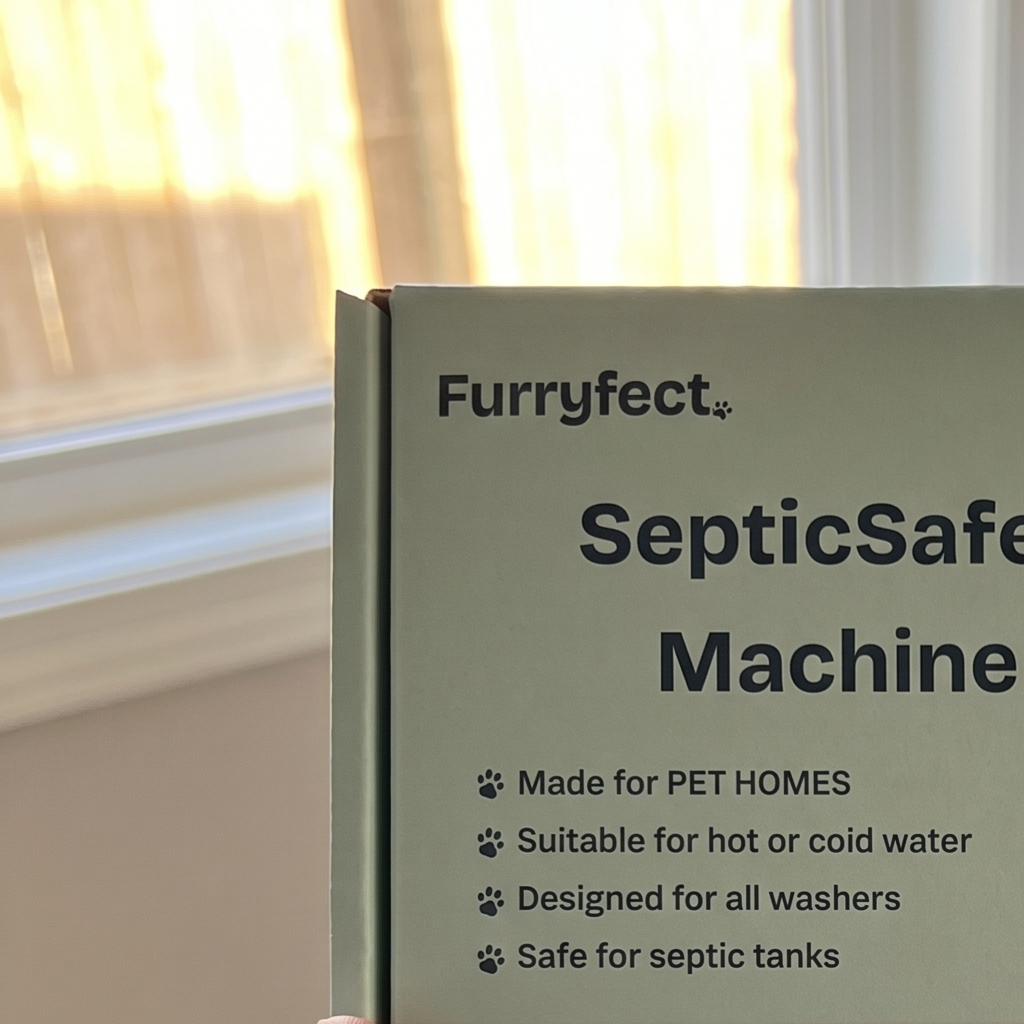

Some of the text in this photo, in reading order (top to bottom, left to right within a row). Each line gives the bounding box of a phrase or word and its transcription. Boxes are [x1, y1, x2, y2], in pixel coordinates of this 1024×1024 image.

[438, 369, 711, 427] Furryfect
[660, 626, 1017, 694] Machine
[519, 768, 851, 796] Made for PET HOMES
[517, 826, 646, 854] Suitable
[653, 826, 699, 854] for
[708, 826, 759, 854] hot
[767, 833, 801, 854] or
[882, 828, 973, 854] water
[518, 883, 901, 918] Designed for all washers
[517, 941, 840, 975] Safe for septic tanks
